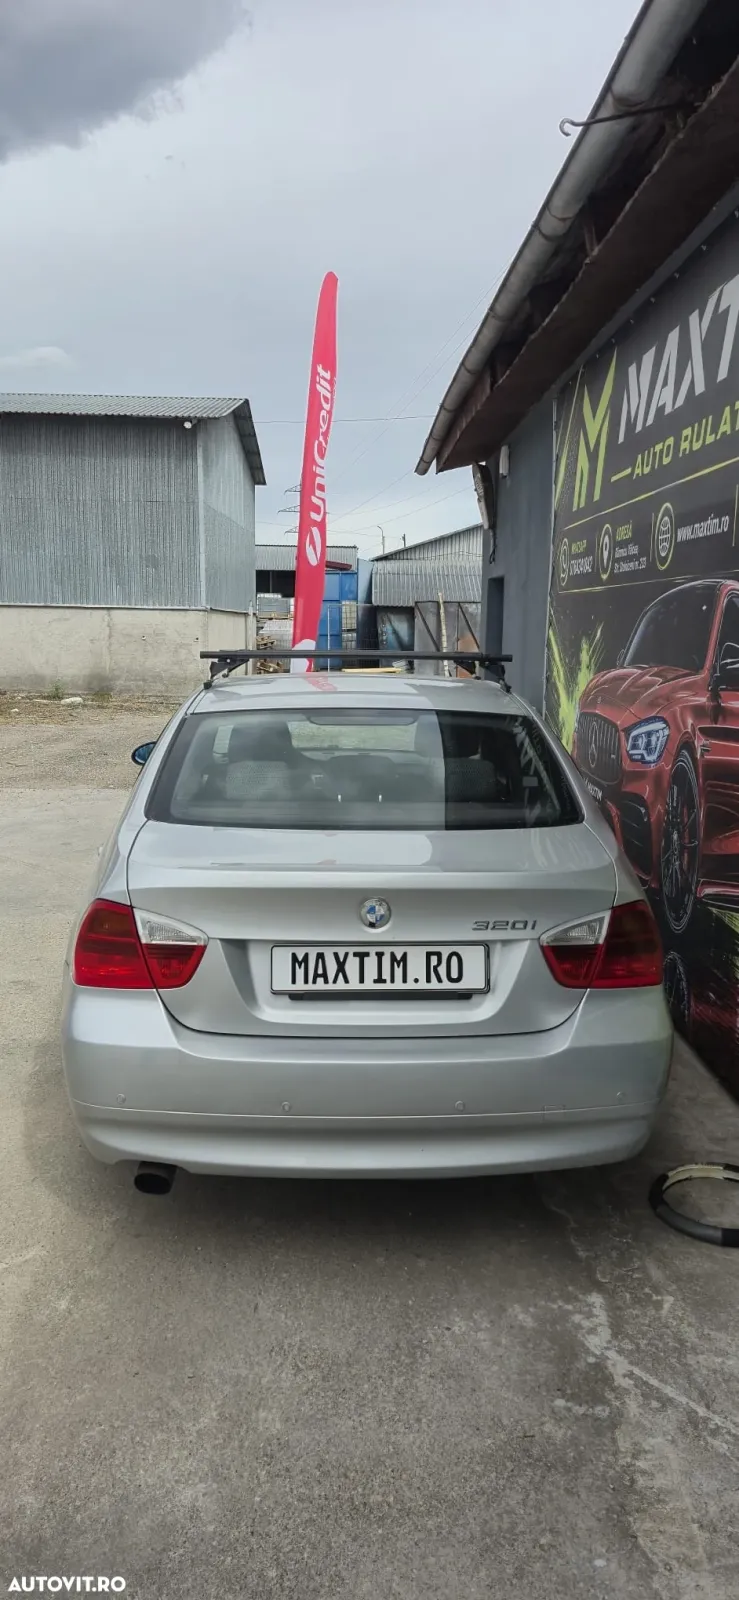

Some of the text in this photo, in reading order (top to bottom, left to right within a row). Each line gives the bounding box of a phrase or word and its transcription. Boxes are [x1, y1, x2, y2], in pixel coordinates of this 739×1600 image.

[310, 364, 332, 522] UniCredit
[633, 436, 674, 479] AUTO
[677, 513, 730, 542] www.maxtim.ro
[472, 920, 537, 931] 320i
[291, 951, 463, 985] MAXTIM.RO
